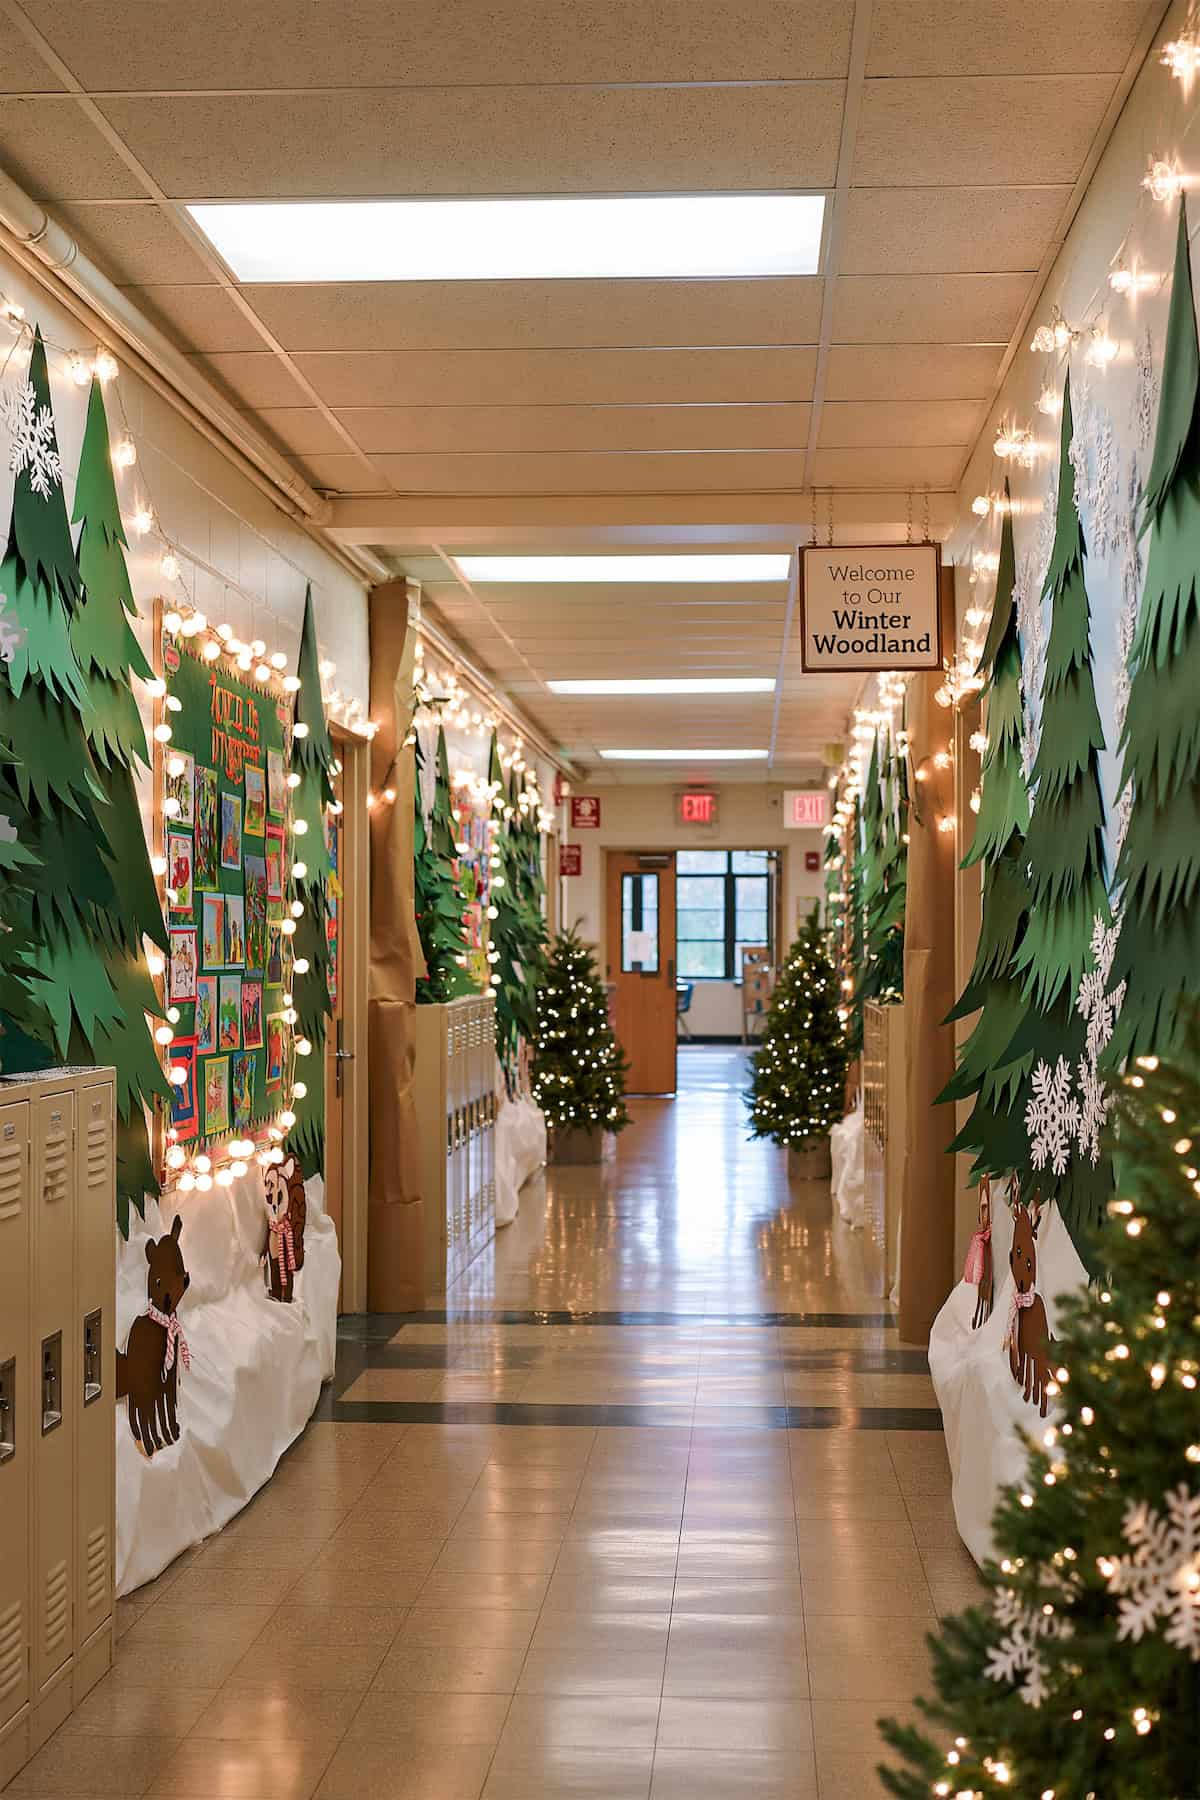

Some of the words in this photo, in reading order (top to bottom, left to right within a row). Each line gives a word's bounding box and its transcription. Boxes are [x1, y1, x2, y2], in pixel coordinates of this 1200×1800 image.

[828, 565, 915, 582] Welcome
[842, 591, 862, 605] to
[867, 588, 902, 604] Our
[832, 610, 911, 630] Winter
[812, 633, 931, 654] Woodland
[682, 795, 714, 821] EXIT
[794, 796, 825, 822] EXIT
